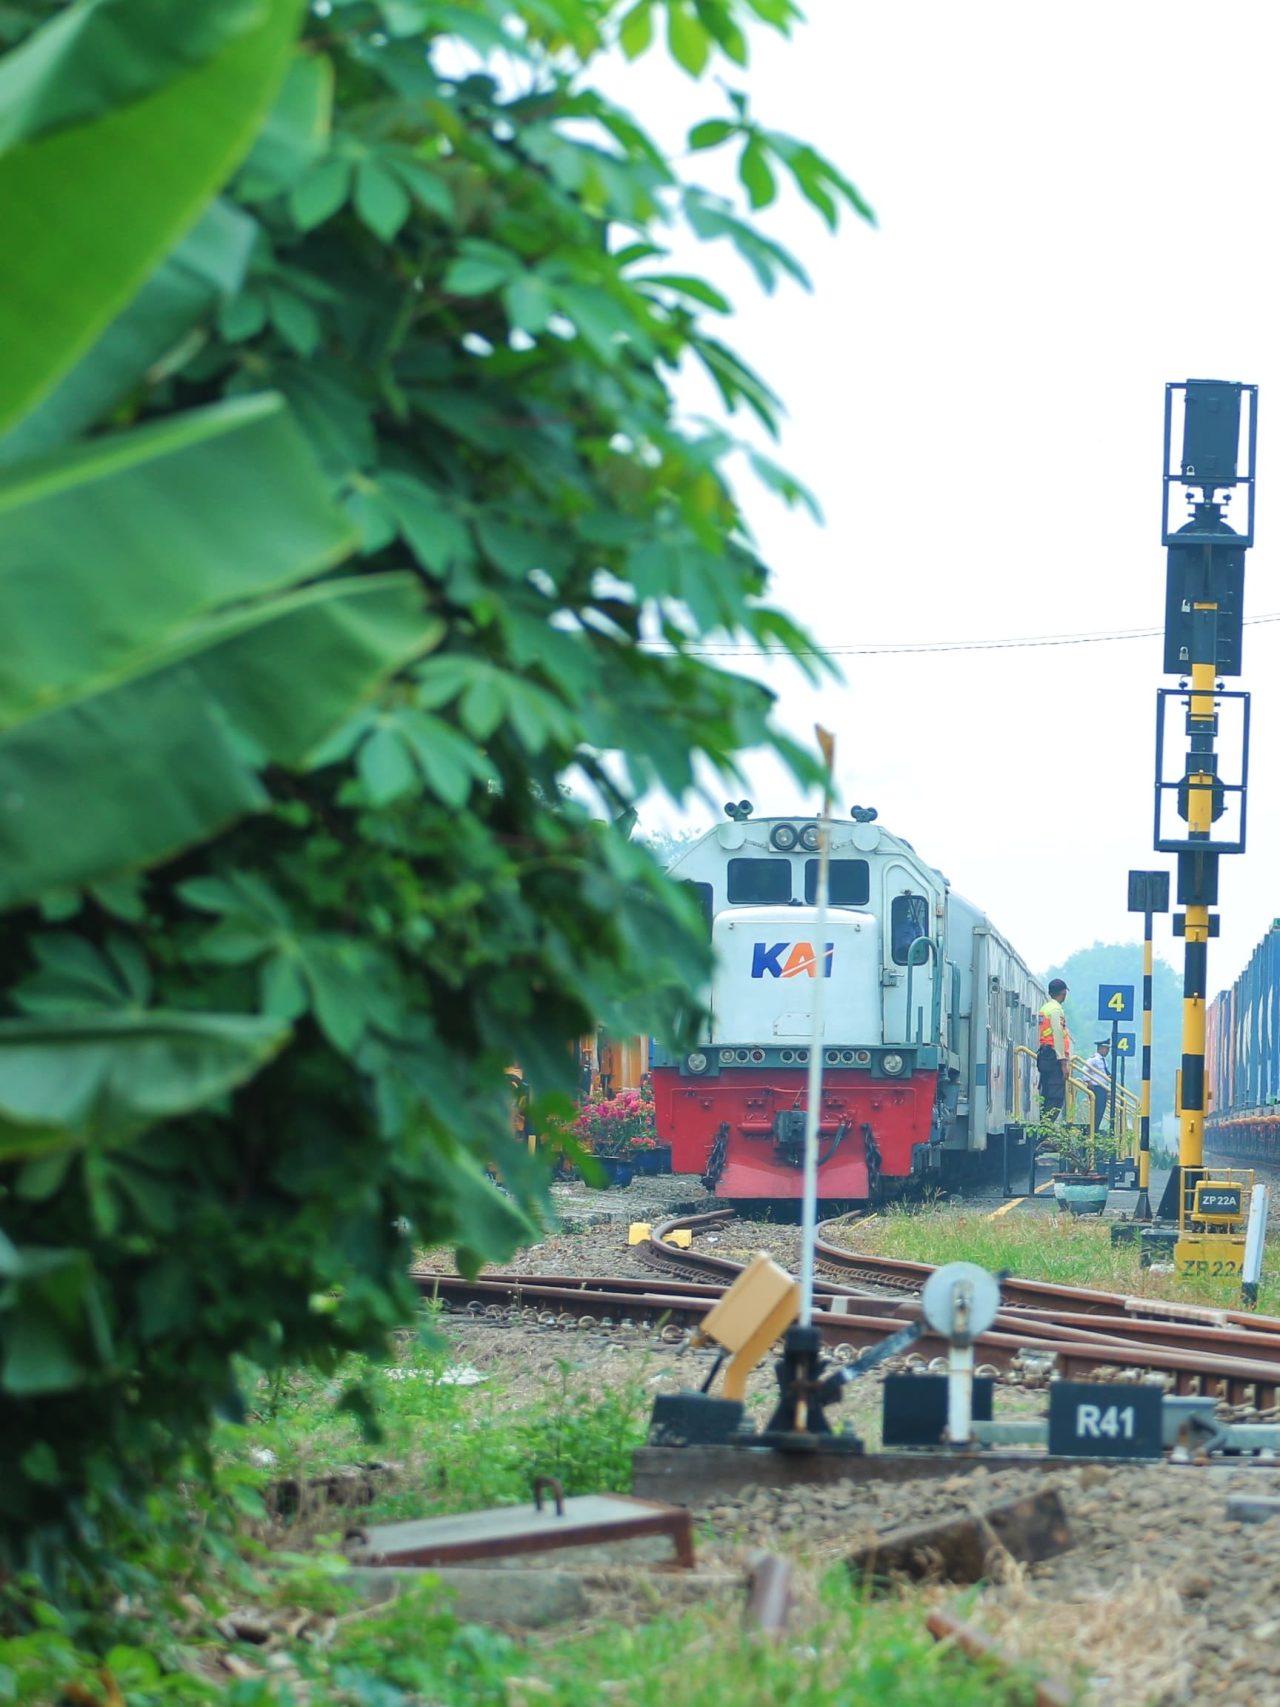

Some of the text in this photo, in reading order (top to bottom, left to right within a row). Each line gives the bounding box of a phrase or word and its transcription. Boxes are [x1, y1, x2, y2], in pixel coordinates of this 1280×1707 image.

[751, 942, 834, 978] KAI
[1107, 992, 1125, 1012] 4
[1117, 1037, 1128, 1051] 4
[1202, 1195, 1237, 1206] ZP 22A
[1076, 1404, 1134, 1438] R41
